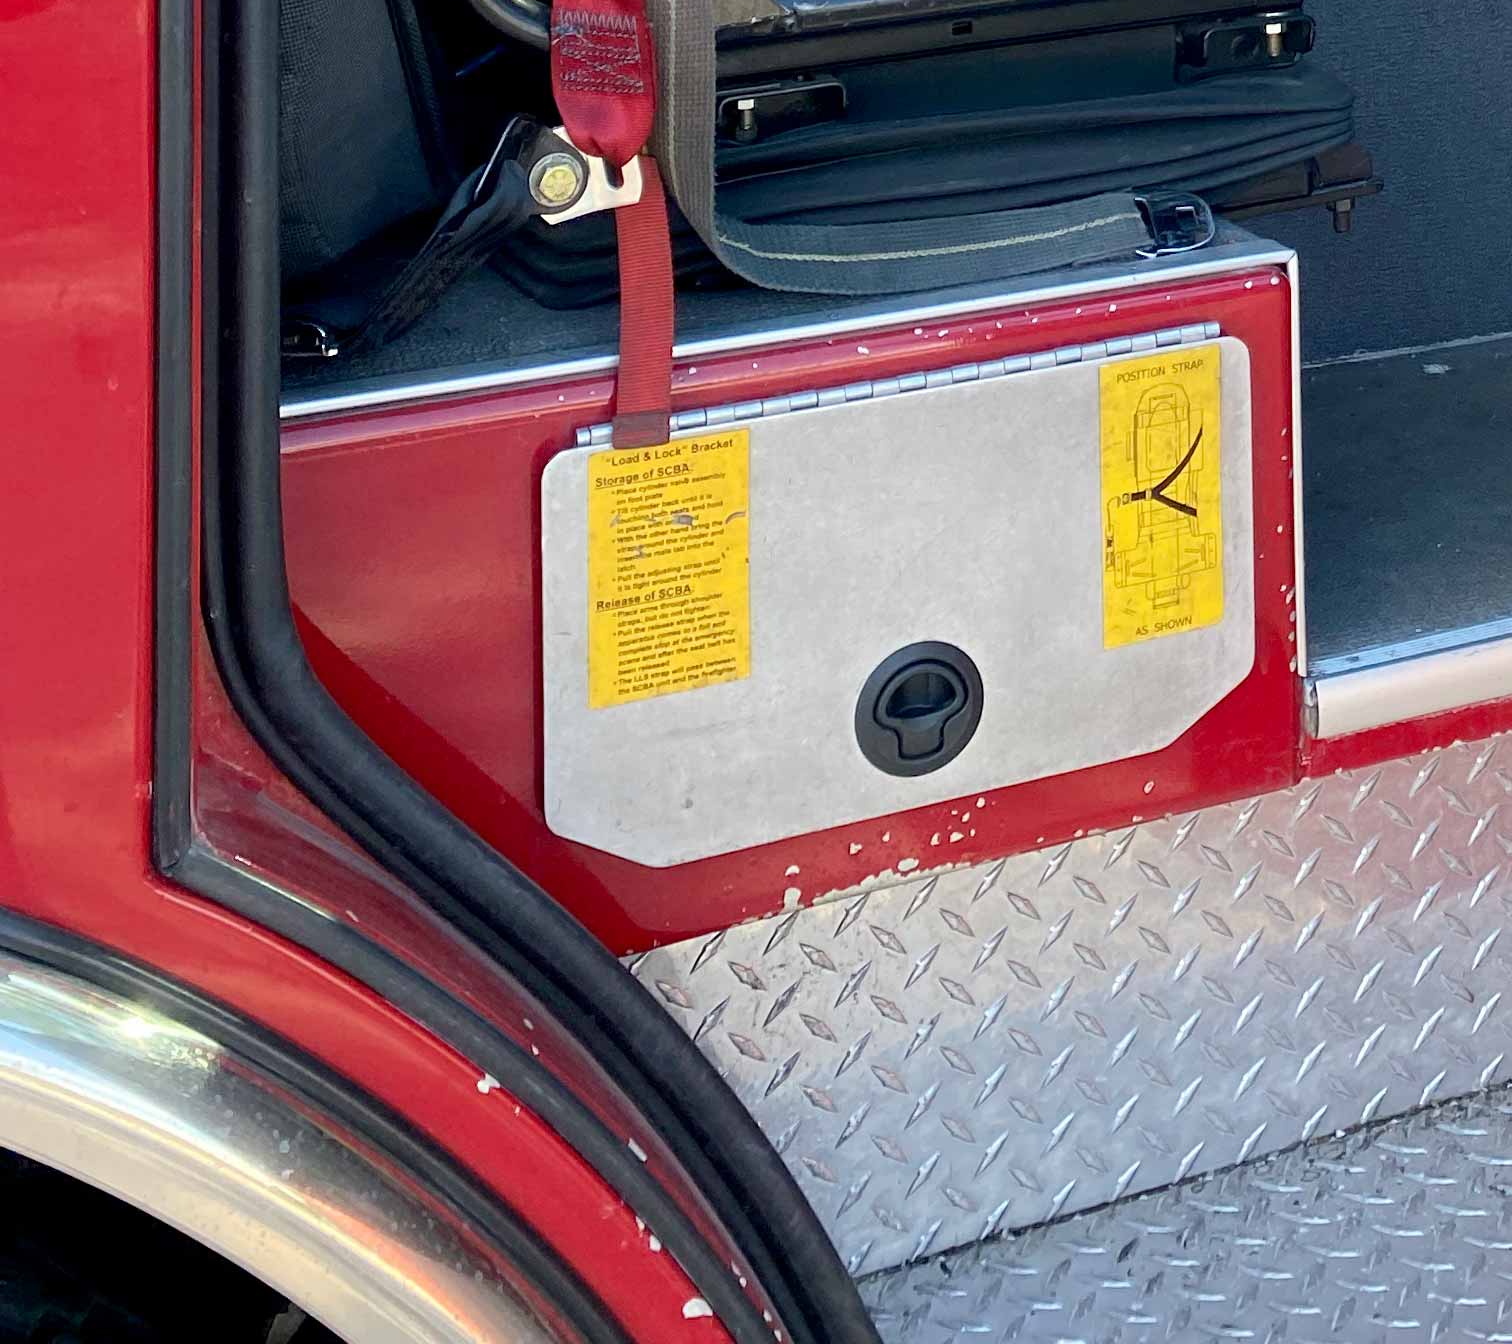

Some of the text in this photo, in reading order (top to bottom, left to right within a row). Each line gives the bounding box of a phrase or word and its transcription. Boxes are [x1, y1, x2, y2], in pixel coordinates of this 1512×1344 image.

[1116, 359, 1204, 384] POSITION STRAP
[643, 452, 651, 461] &
[691, 438, 732, 453] Bracket
[595, 472, 638, 488] Storage
[642, 470, 652, 478] of
[596, 594, 640, 609] Release
[644, 591, 655, 600] of
[1136, 616, 1192, 635] AS SHOWN
